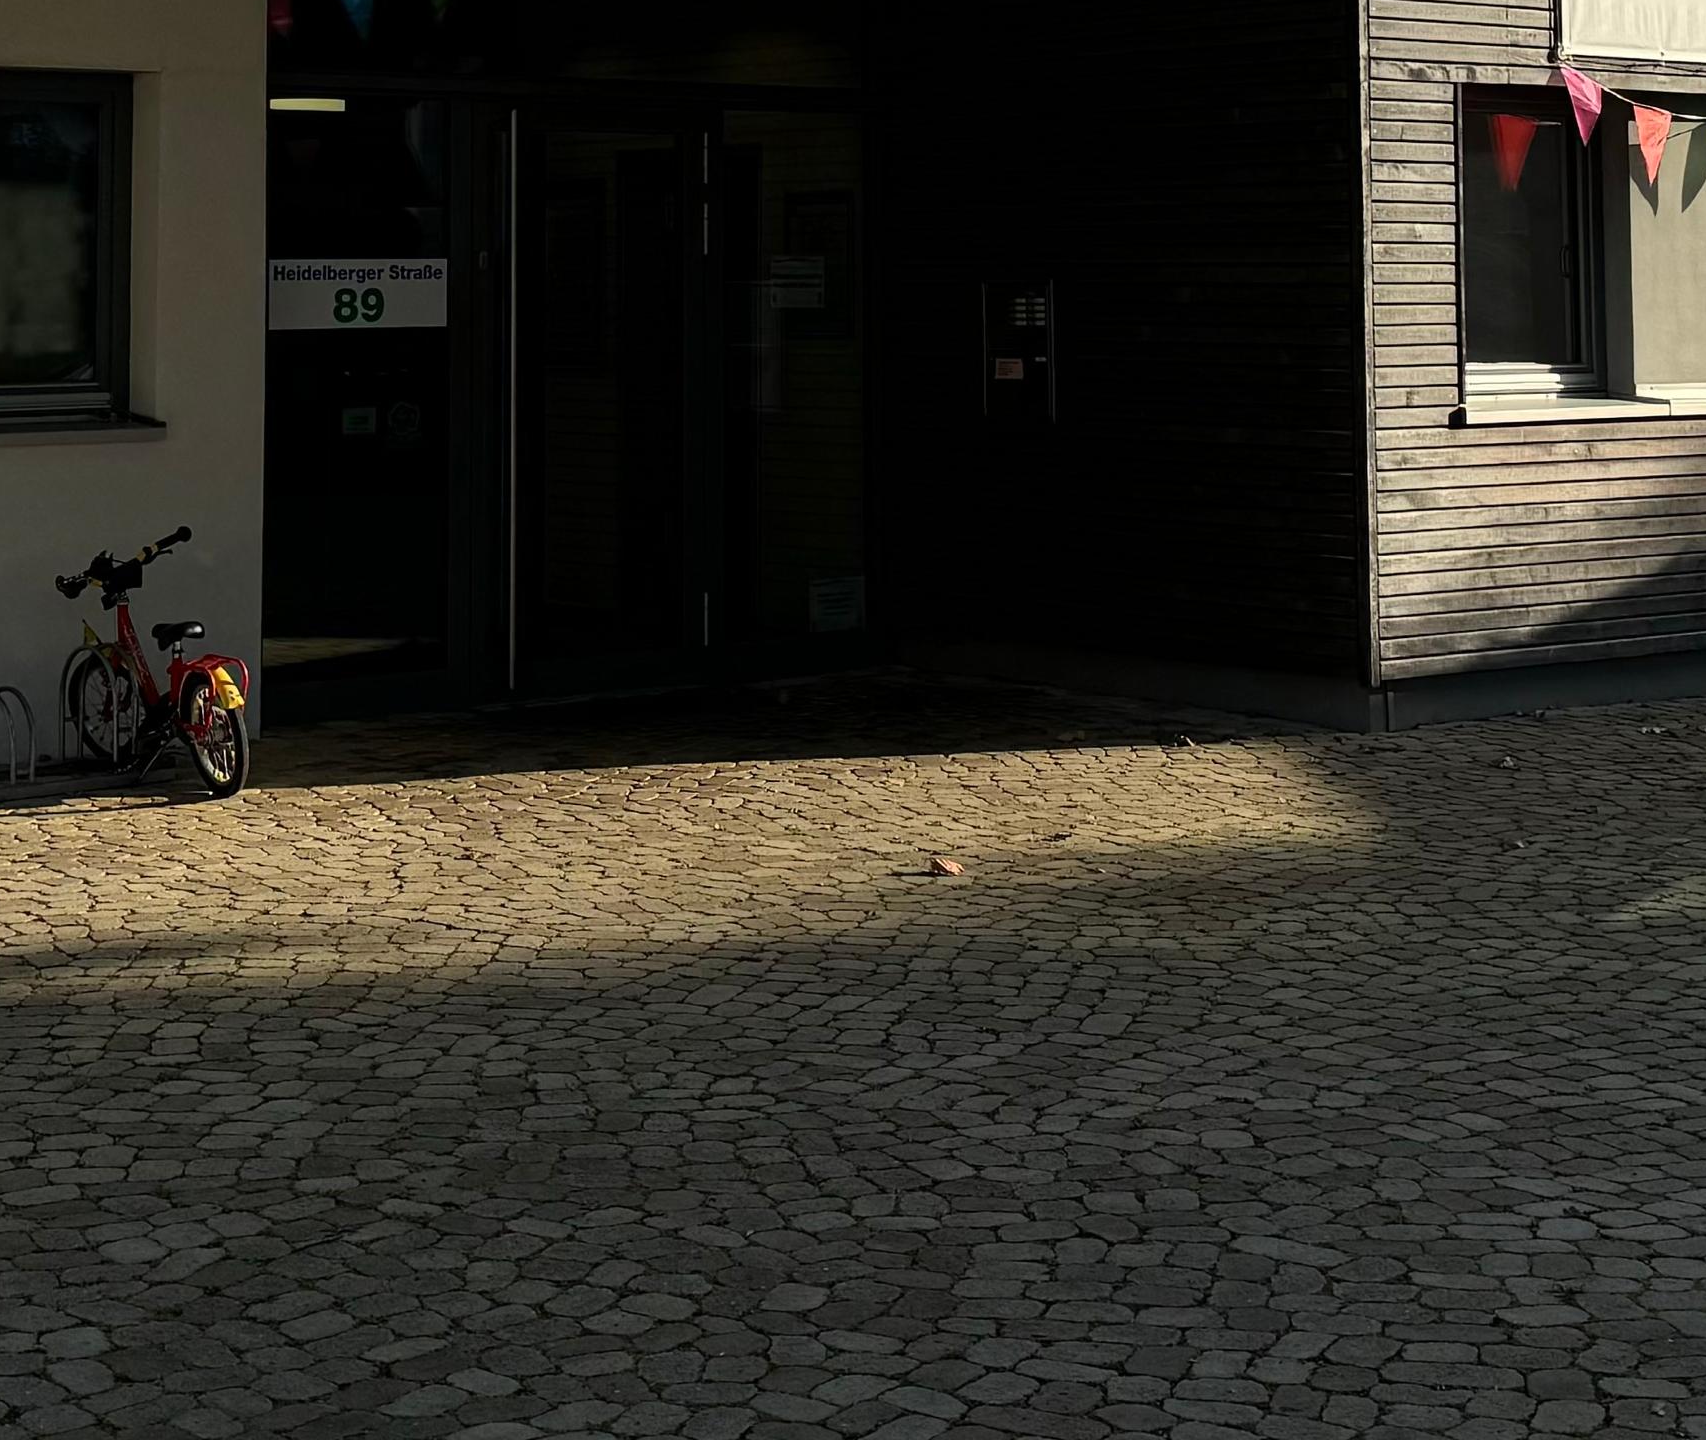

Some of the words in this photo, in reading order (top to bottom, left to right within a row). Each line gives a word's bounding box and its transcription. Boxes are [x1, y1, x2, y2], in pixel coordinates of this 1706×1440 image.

[273, 265, 384, 283] Heidelberger
[389, 265, 443, 280] Straße
[333, 287, 384, 323] 89
